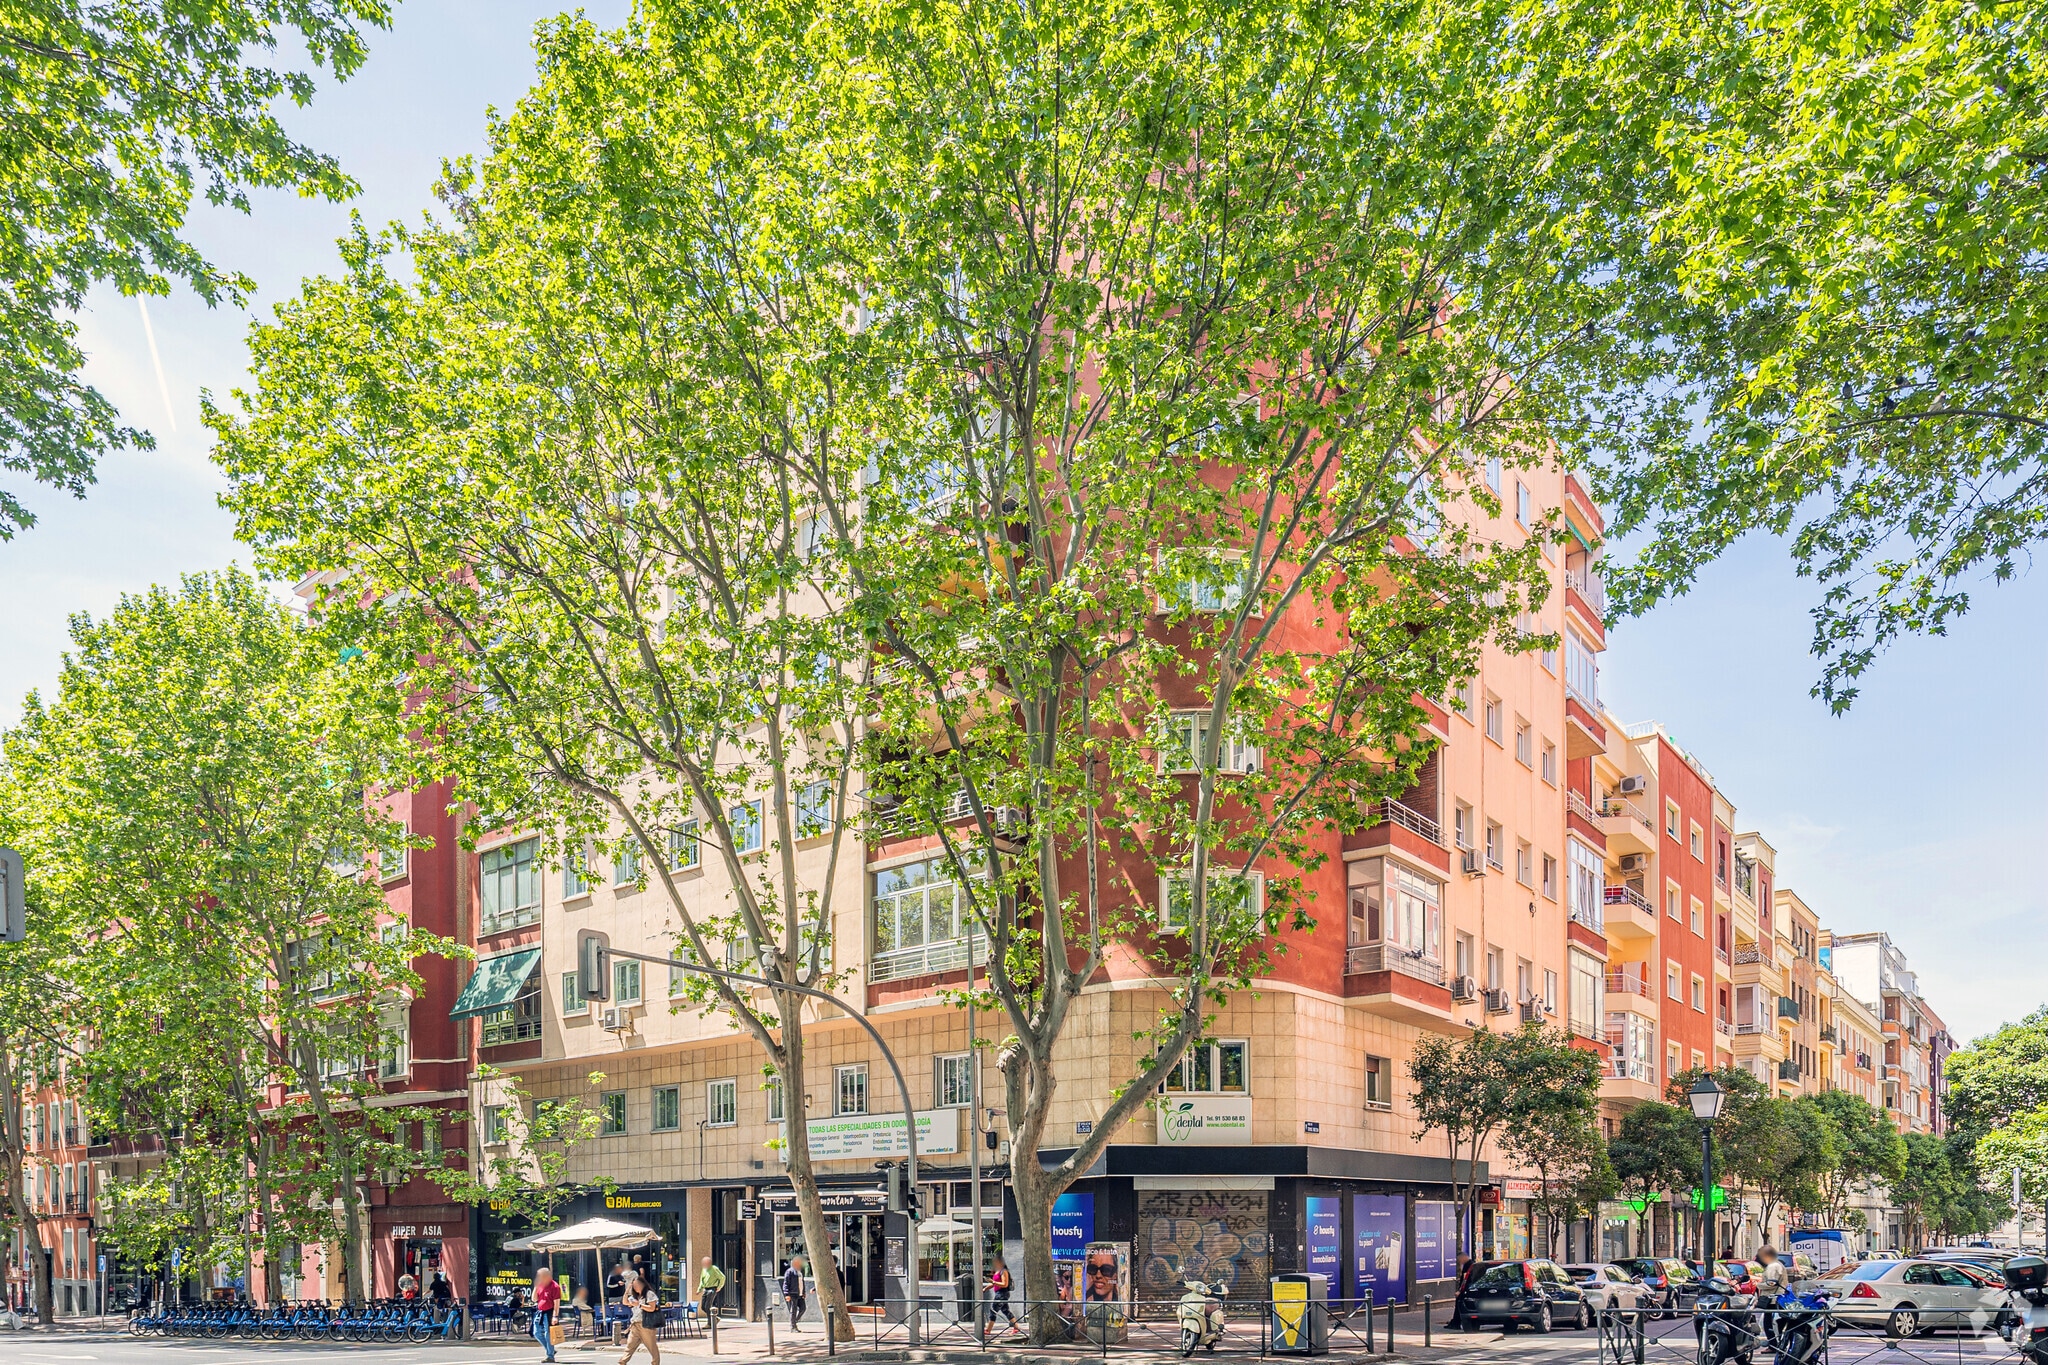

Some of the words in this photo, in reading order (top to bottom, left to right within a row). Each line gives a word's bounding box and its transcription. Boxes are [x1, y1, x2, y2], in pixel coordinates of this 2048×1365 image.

[808, 1125, 825, 1133] TODAS
[826, 1124, 836, 1132] LAS
[837, 1121, 881, 1131] ESPECIALIDADES
[883, 1120, 890, 1128] EN
[891, 1117, 931, 1128] ODONLOGÍA
[615, 1196, 631, 1208] BM
[392, 1225, 416, 1236] HIPER
[422, 1225, 442, 1236] ASIA
[1052, 1226, 1083, 1239] housfy
[486, 1286, 506, 1297] 9:00h
